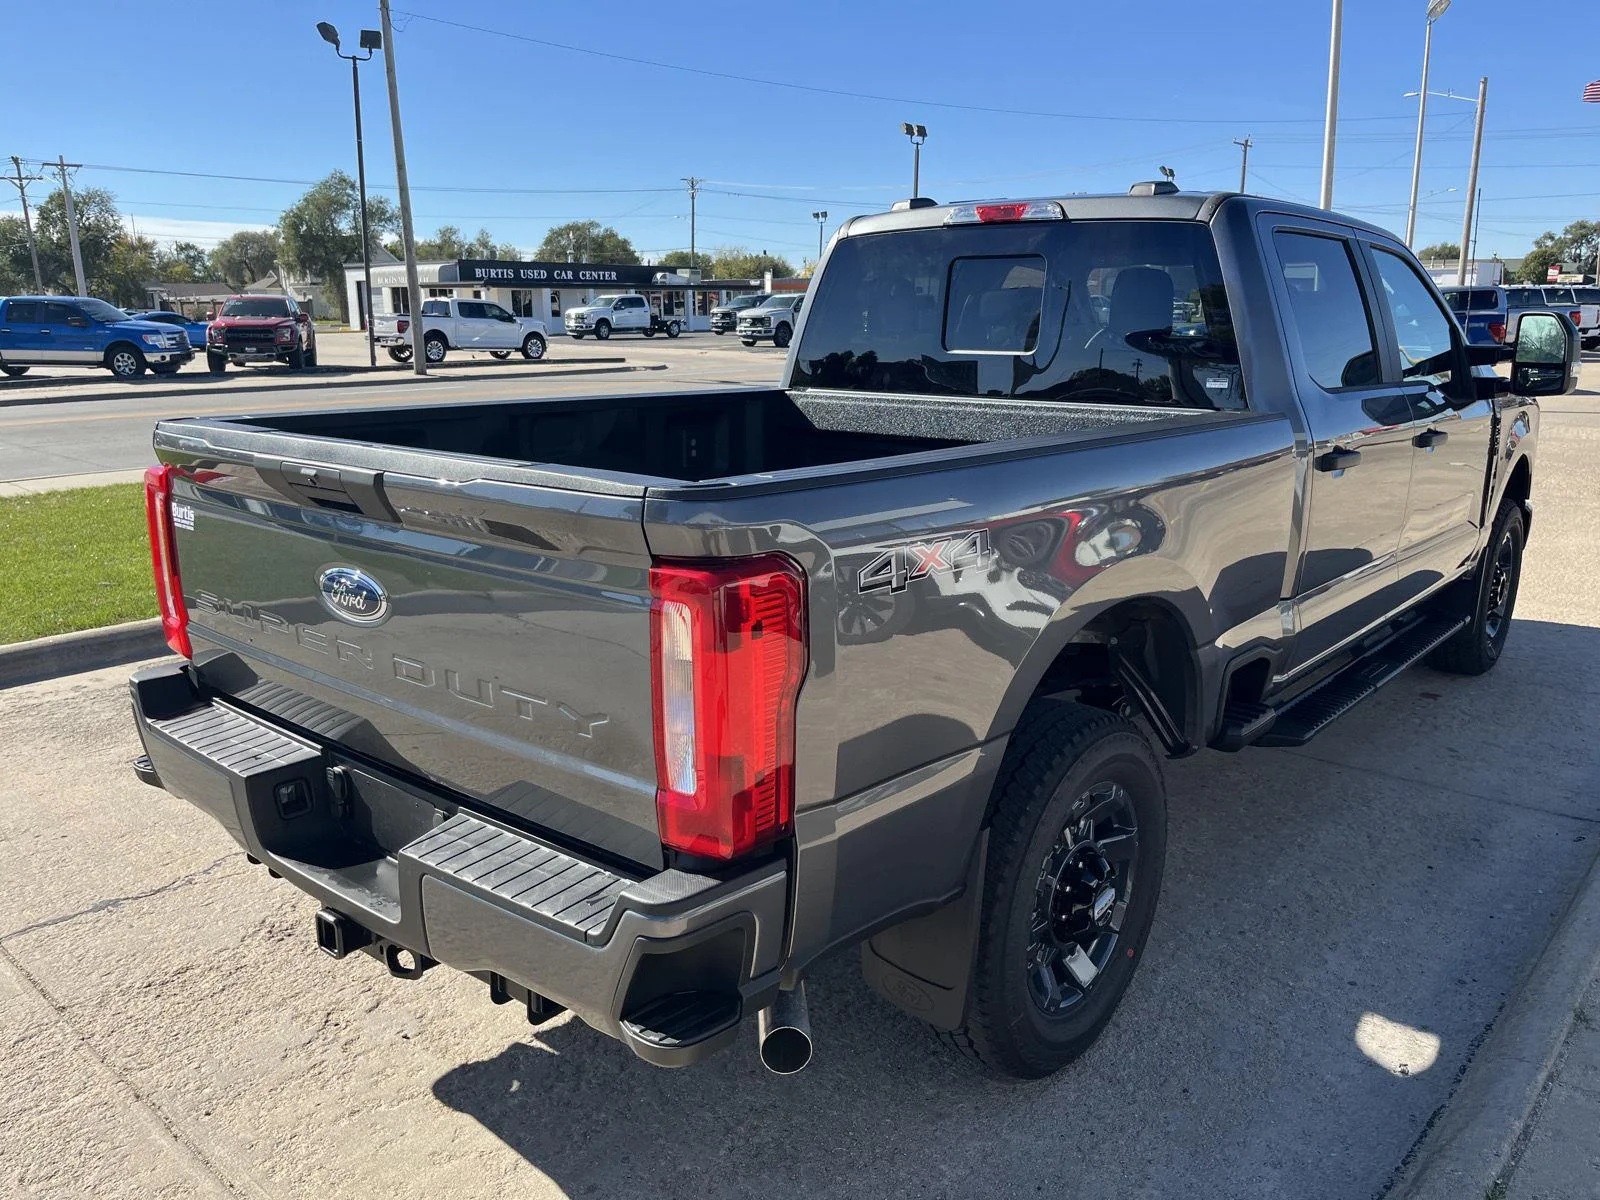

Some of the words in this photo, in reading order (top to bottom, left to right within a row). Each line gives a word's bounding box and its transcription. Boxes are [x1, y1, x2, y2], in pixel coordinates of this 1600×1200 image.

[474, 268, 514, 280] BURTIS
[520, 269, 548, 280] USED
[554, 270, 574, 280] CAR
[579, 270, 618, 281] CENTER
[171, 501, 195, 522] Burtis
[330, 577, 367, 611] Ford
[195, 589, 375, 671] SUPER
[392, 652, 610, 739] DUTY
